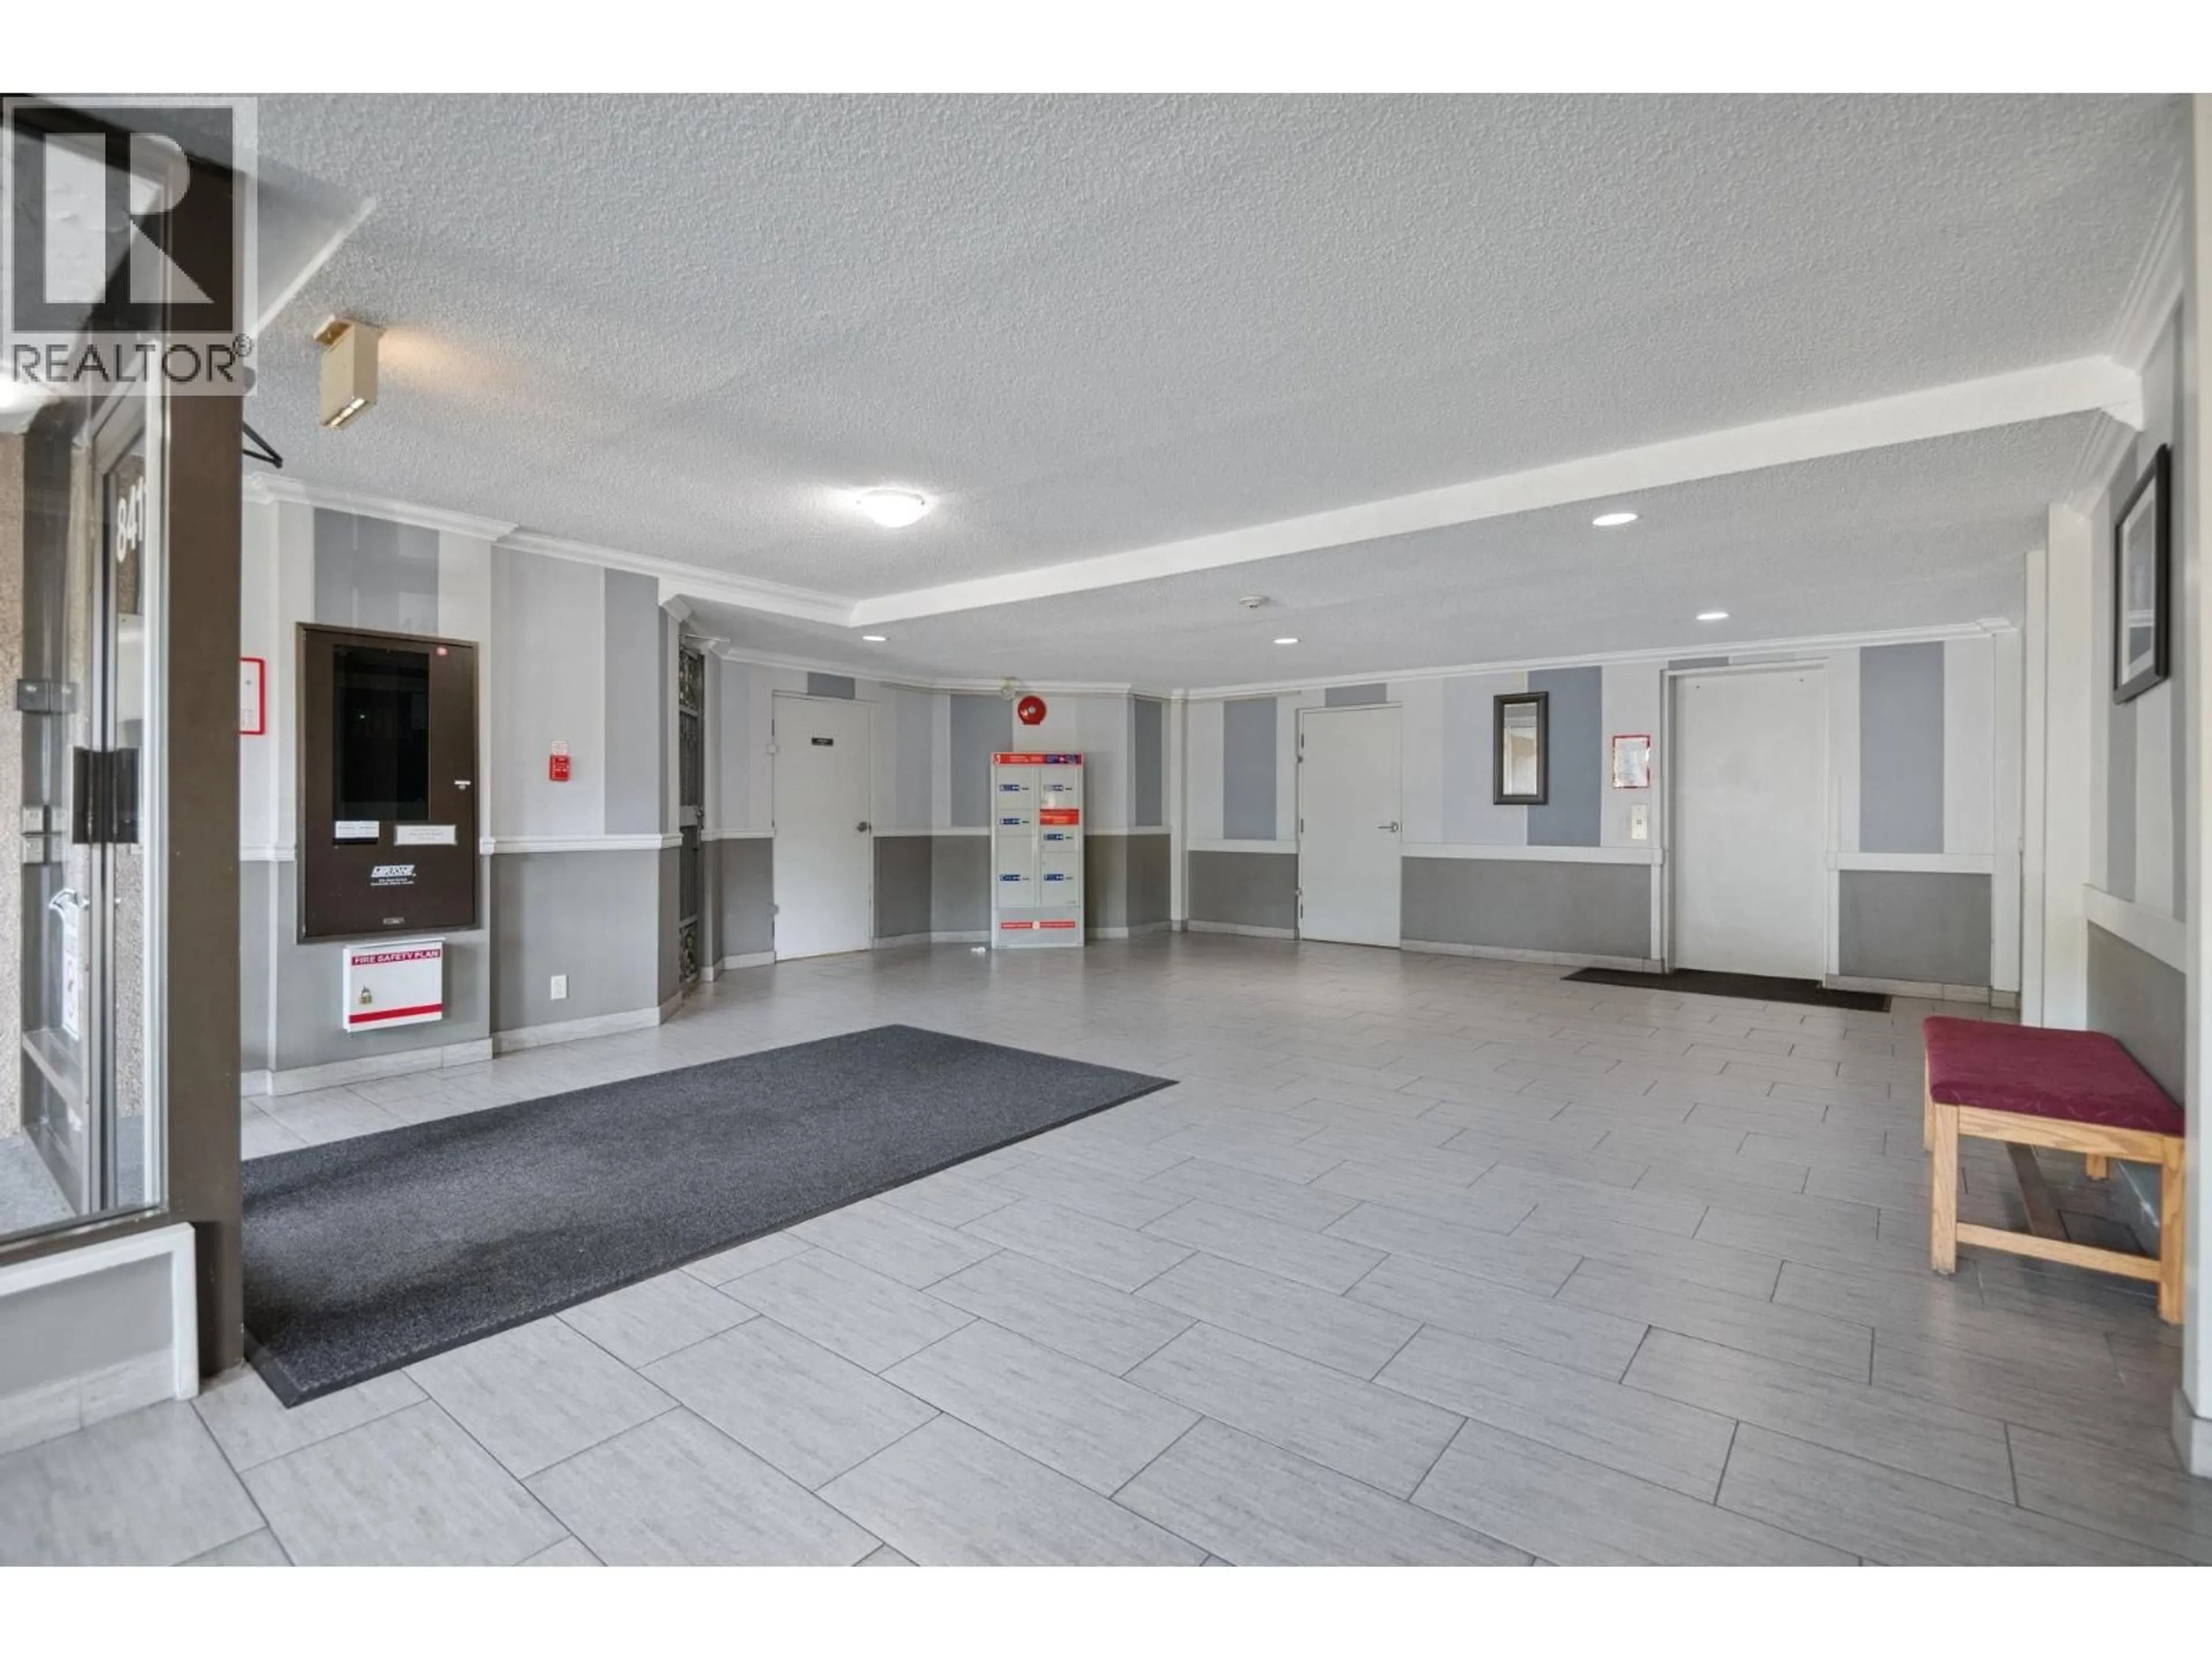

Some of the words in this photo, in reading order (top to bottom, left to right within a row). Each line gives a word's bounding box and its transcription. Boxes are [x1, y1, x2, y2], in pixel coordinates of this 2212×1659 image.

[117, 476, 147, 563] 841
[354, 956, 376, 964] FIRE
[377, 952, 413, 962] SAFETY
[414, 950, 439, 959] PLAN
